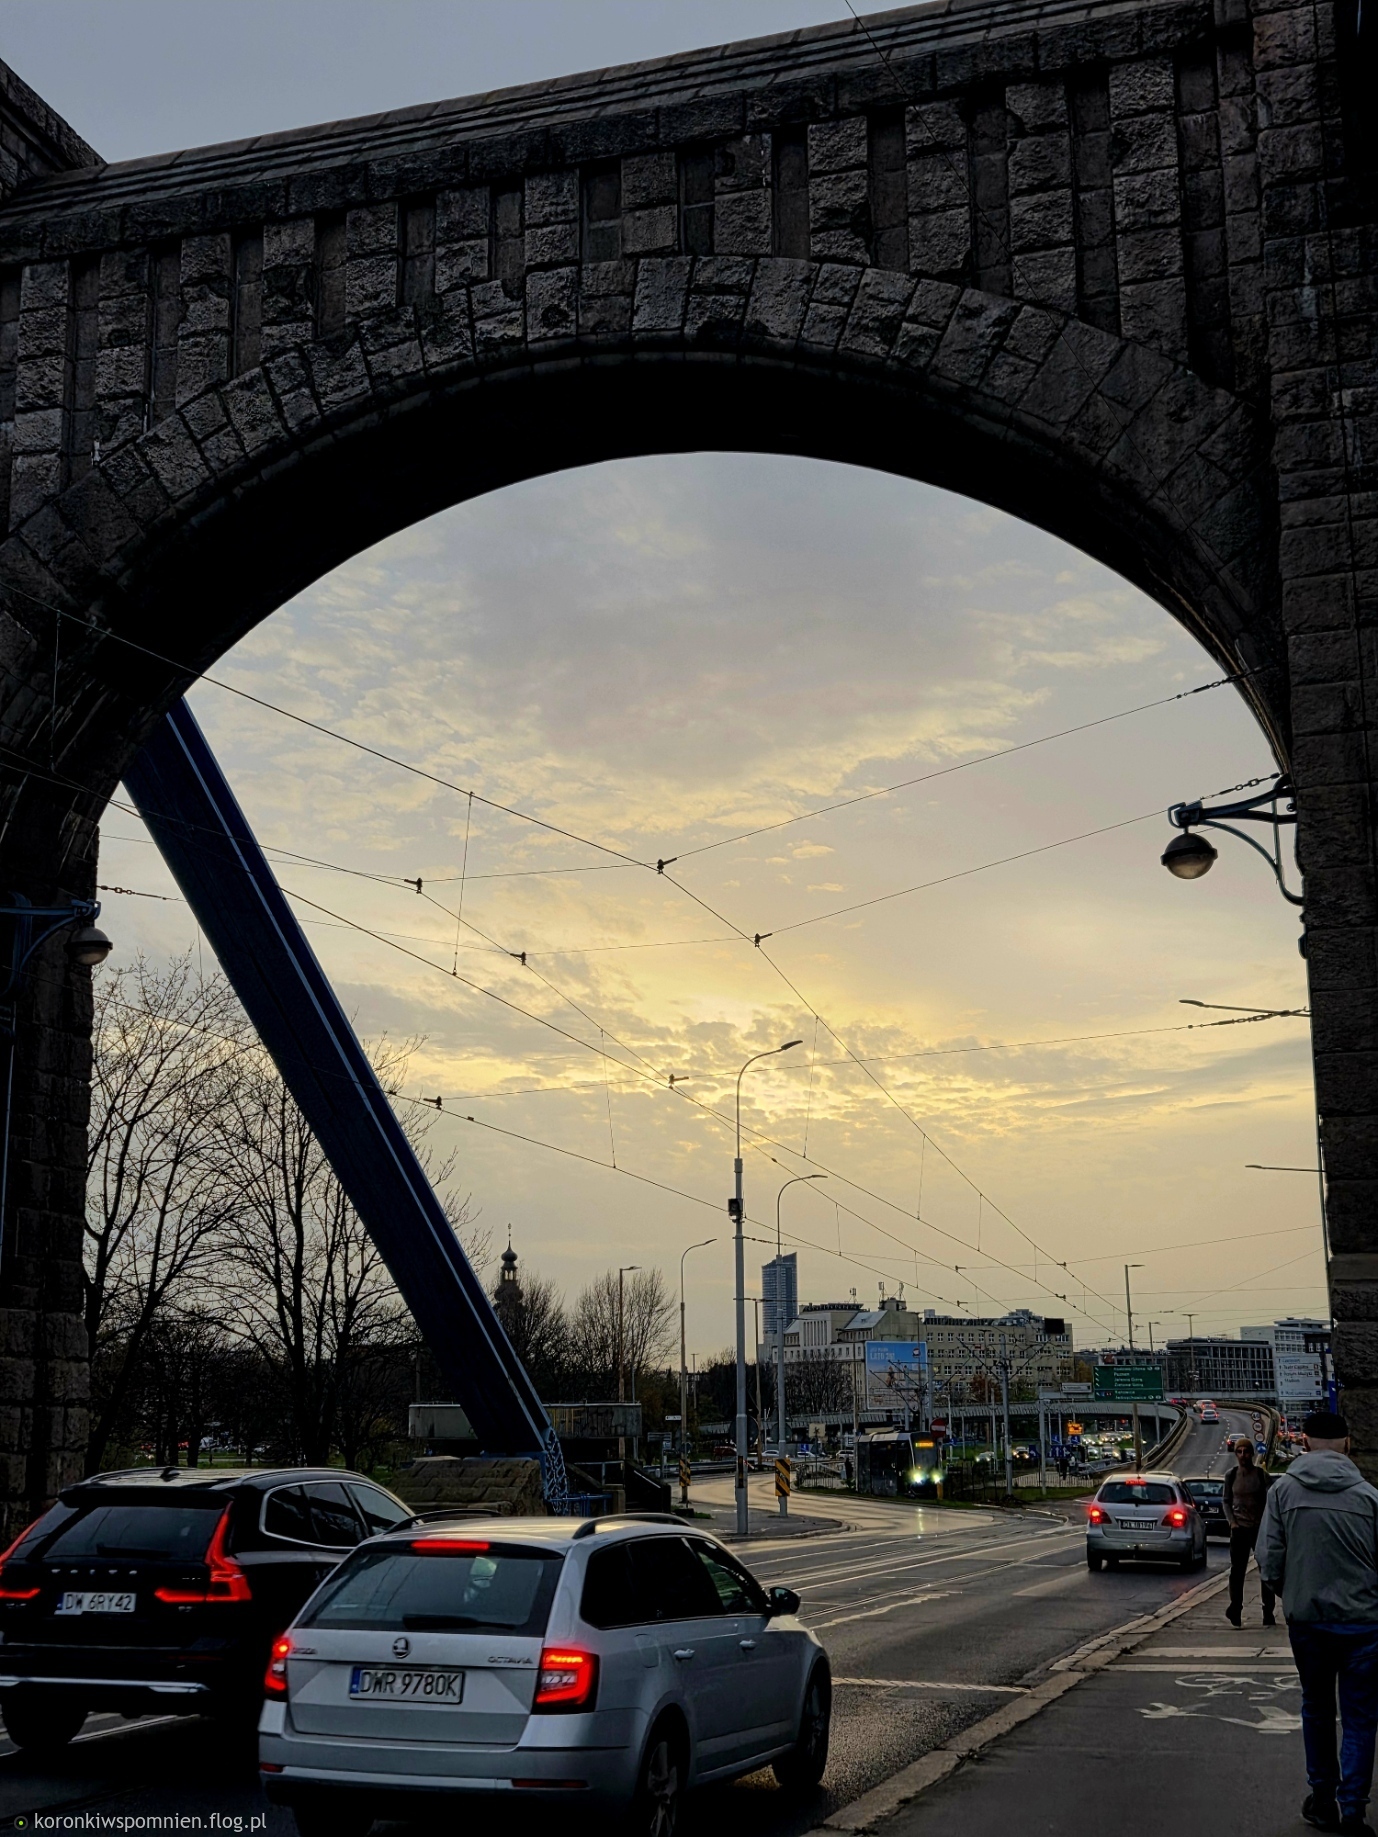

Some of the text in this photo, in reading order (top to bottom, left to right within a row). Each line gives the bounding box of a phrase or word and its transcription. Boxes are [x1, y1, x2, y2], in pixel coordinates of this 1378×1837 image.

[65, 1593, 132, 1611] DW 6RY42
[487, 1656, 533, 1664] OCTAVIA
[359, 1671, 460, 1697] DWR 9780K
